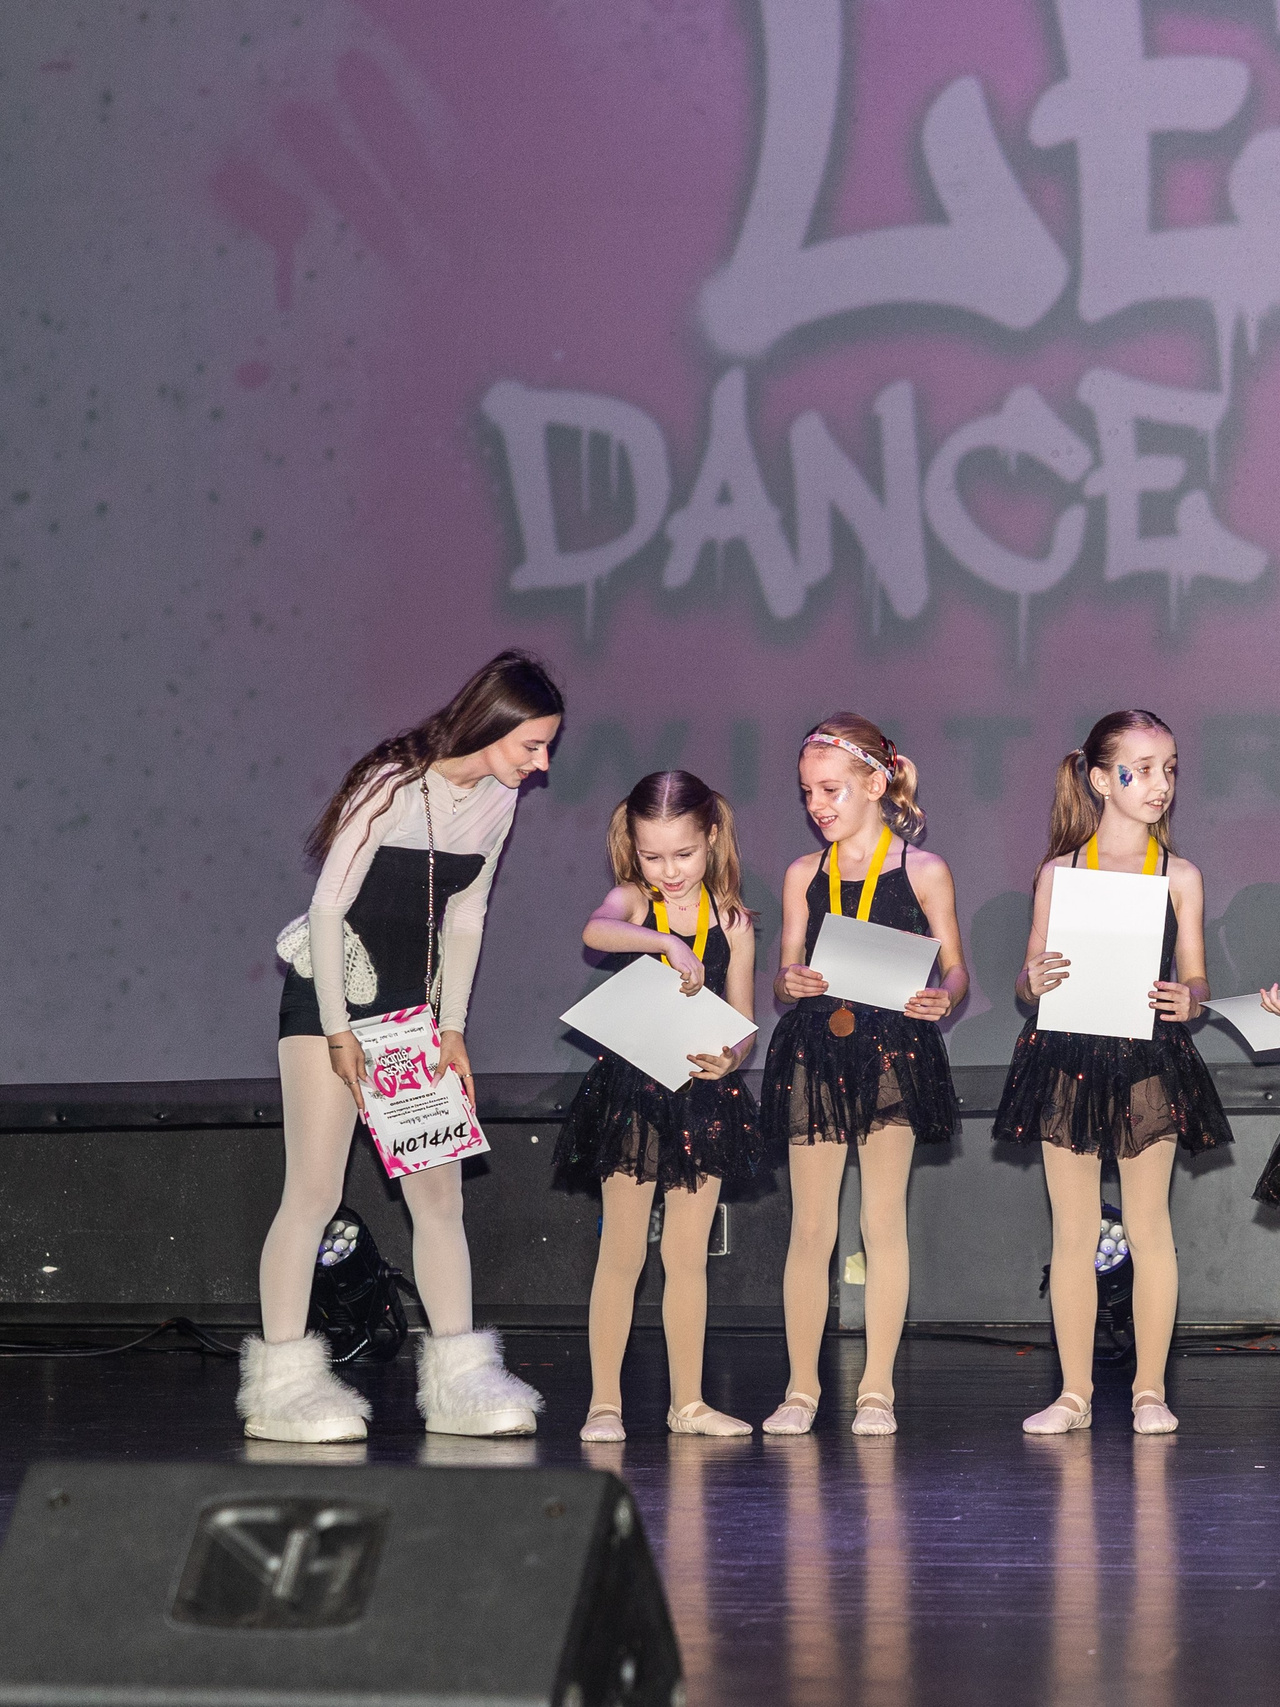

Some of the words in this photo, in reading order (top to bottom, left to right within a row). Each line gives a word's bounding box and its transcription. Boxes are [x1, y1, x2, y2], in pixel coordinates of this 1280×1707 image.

[482, 367, 1268, 622] DANCE
[380, 1050, 409, 1067] STUDIO
[384, 1060, 415, 1077] DANCE
[393, 1121, 469, 1156] DYPLOM
